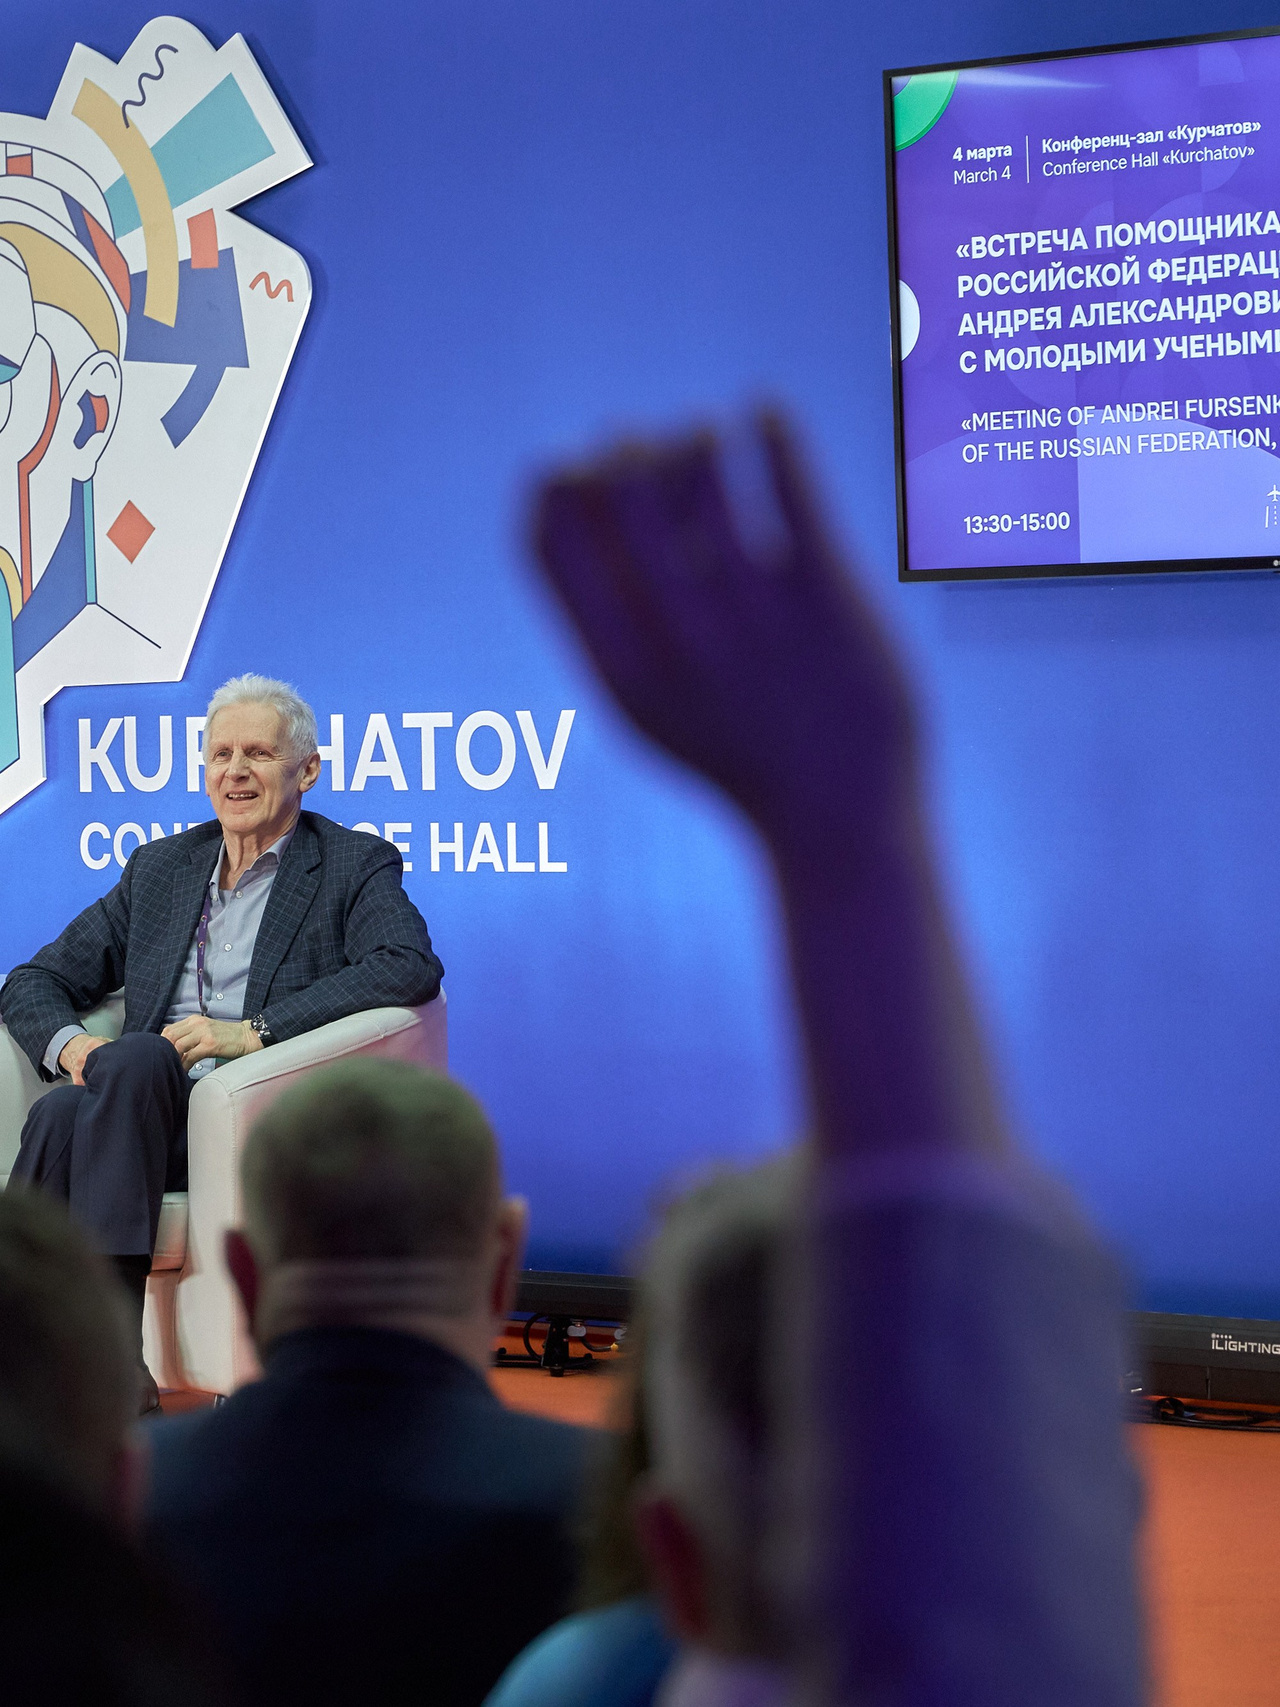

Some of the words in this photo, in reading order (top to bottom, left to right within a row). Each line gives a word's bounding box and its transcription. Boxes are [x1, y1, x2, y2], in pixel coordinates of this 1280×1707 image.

[1042, 128, 1164, 154] Конференц-зал
[1168, 120, 1262, 144] «Курчатов»
[952, 147, 962, 162] 4
[966, 145, 1012, 164] марта
[1042, 156, 1128, 177] Conference
[1132, 152, 1158, 167] Hall
[1162, 144, 1255, 165] «Kurchatov»
[954, 169, 998, 184] March
[1001, 166, 1011, 180] 4
[956, 228, 1088, 259] «ВСТРЕЧА
[1096, 210, 1280, 249] ПОМОЩНИКА
[958, 256, 1140, 298] РОССИЙСКОЙ
[1148, 250, 1280, 286] ФЕДЕРАЦ
[958, 306, 1062, 338] АНДРЕЯ
[959, 351, 977, 373] С
[984, 340, 1146, 372] МОЛОДЫМИ
[1154, 329, 1280, 360] УЧЕНЫМ
[962, 408, 1062, 432] «MEETING
[1068, 406, 1096, 427] OF
[1101, 400, 1179, 425] ANDREI
[962, 444, 989, 463] OF
[994, 441, 1034, 462] THE
[1040, 435, 1131, 460] RUSSIAN
[1138, 428, 1276, 453] FEDERATION,
[964, 512, 1070, 534] 13:30-15:00
[78, 710, 576, 792] KUHATOV
[430, 822, 568, 872] HALL
